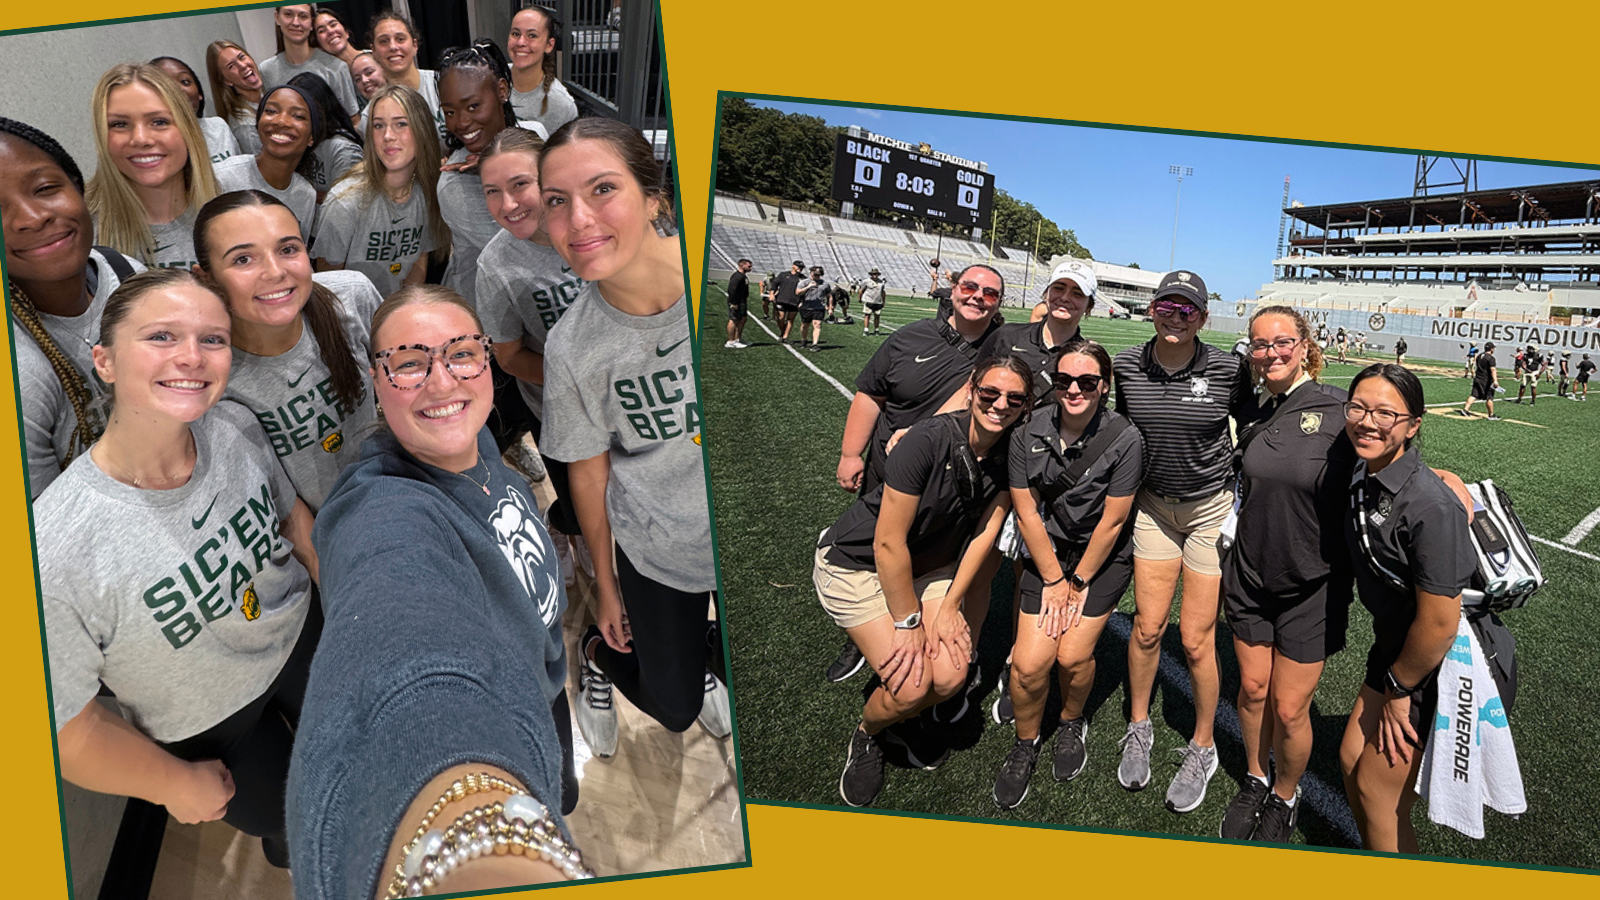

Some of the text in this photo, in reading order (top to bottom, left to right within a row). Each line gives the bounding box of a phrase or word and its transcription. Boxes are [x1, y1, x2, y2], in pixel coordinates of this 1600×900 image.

[846, 140, 891, 164] BLACK
[867, 132, 979, 170] MICHIE STADIUM
[919, 156, 942, 168] QUARTER
[863, 165, 874, 182] 0
[895, 172, 935, 197] 8:03
[956, 169, 985, 188] GOLD
[965, 190, 974, 205] 0
[368, 225, 423, 247] SIC'EM
[365, 241, 420, 262] BEARS
[532, 277, 589, 312] SIC'
[1303, 310, 1329, 323] RMY
[614, 364, 694, 411] SIC'
[256, 375, 340, 433] SIC'E
[142, 483, 277, 623] SIC'EM
[160, 517, 283, 650] BEARS
